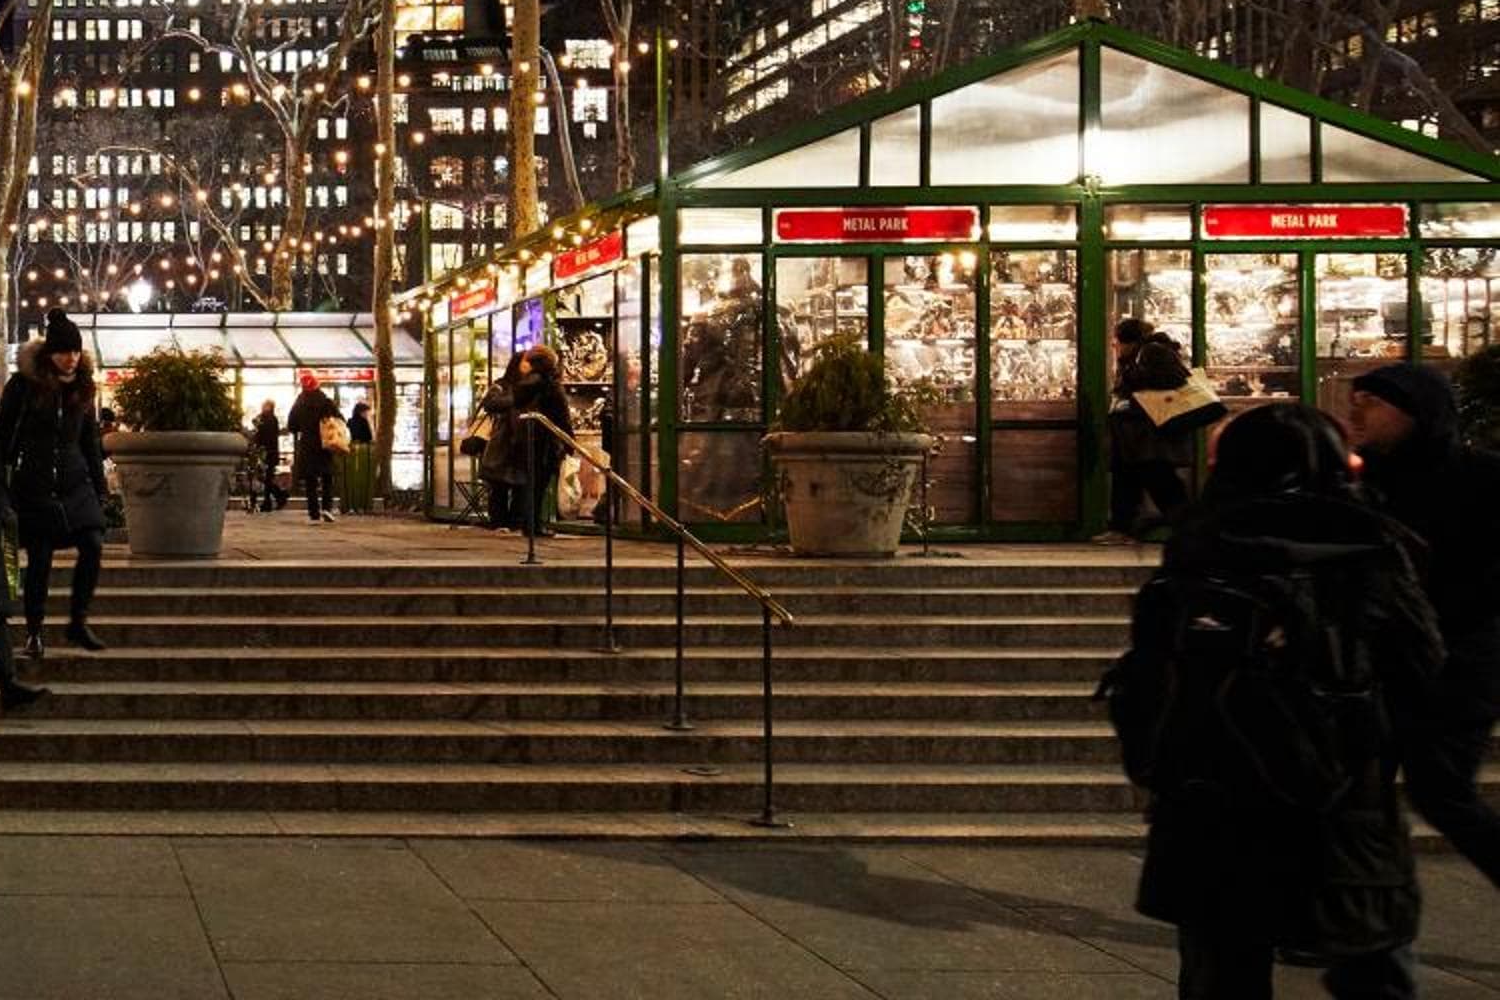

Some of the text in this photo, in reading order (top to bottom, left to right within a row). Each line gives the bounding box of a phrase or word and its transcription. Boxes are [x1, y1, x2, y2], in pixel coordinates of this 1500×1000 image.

[843, 217, 909, 231] METAL PARK
[1271, 214, 1338, 228] METAL PARK
